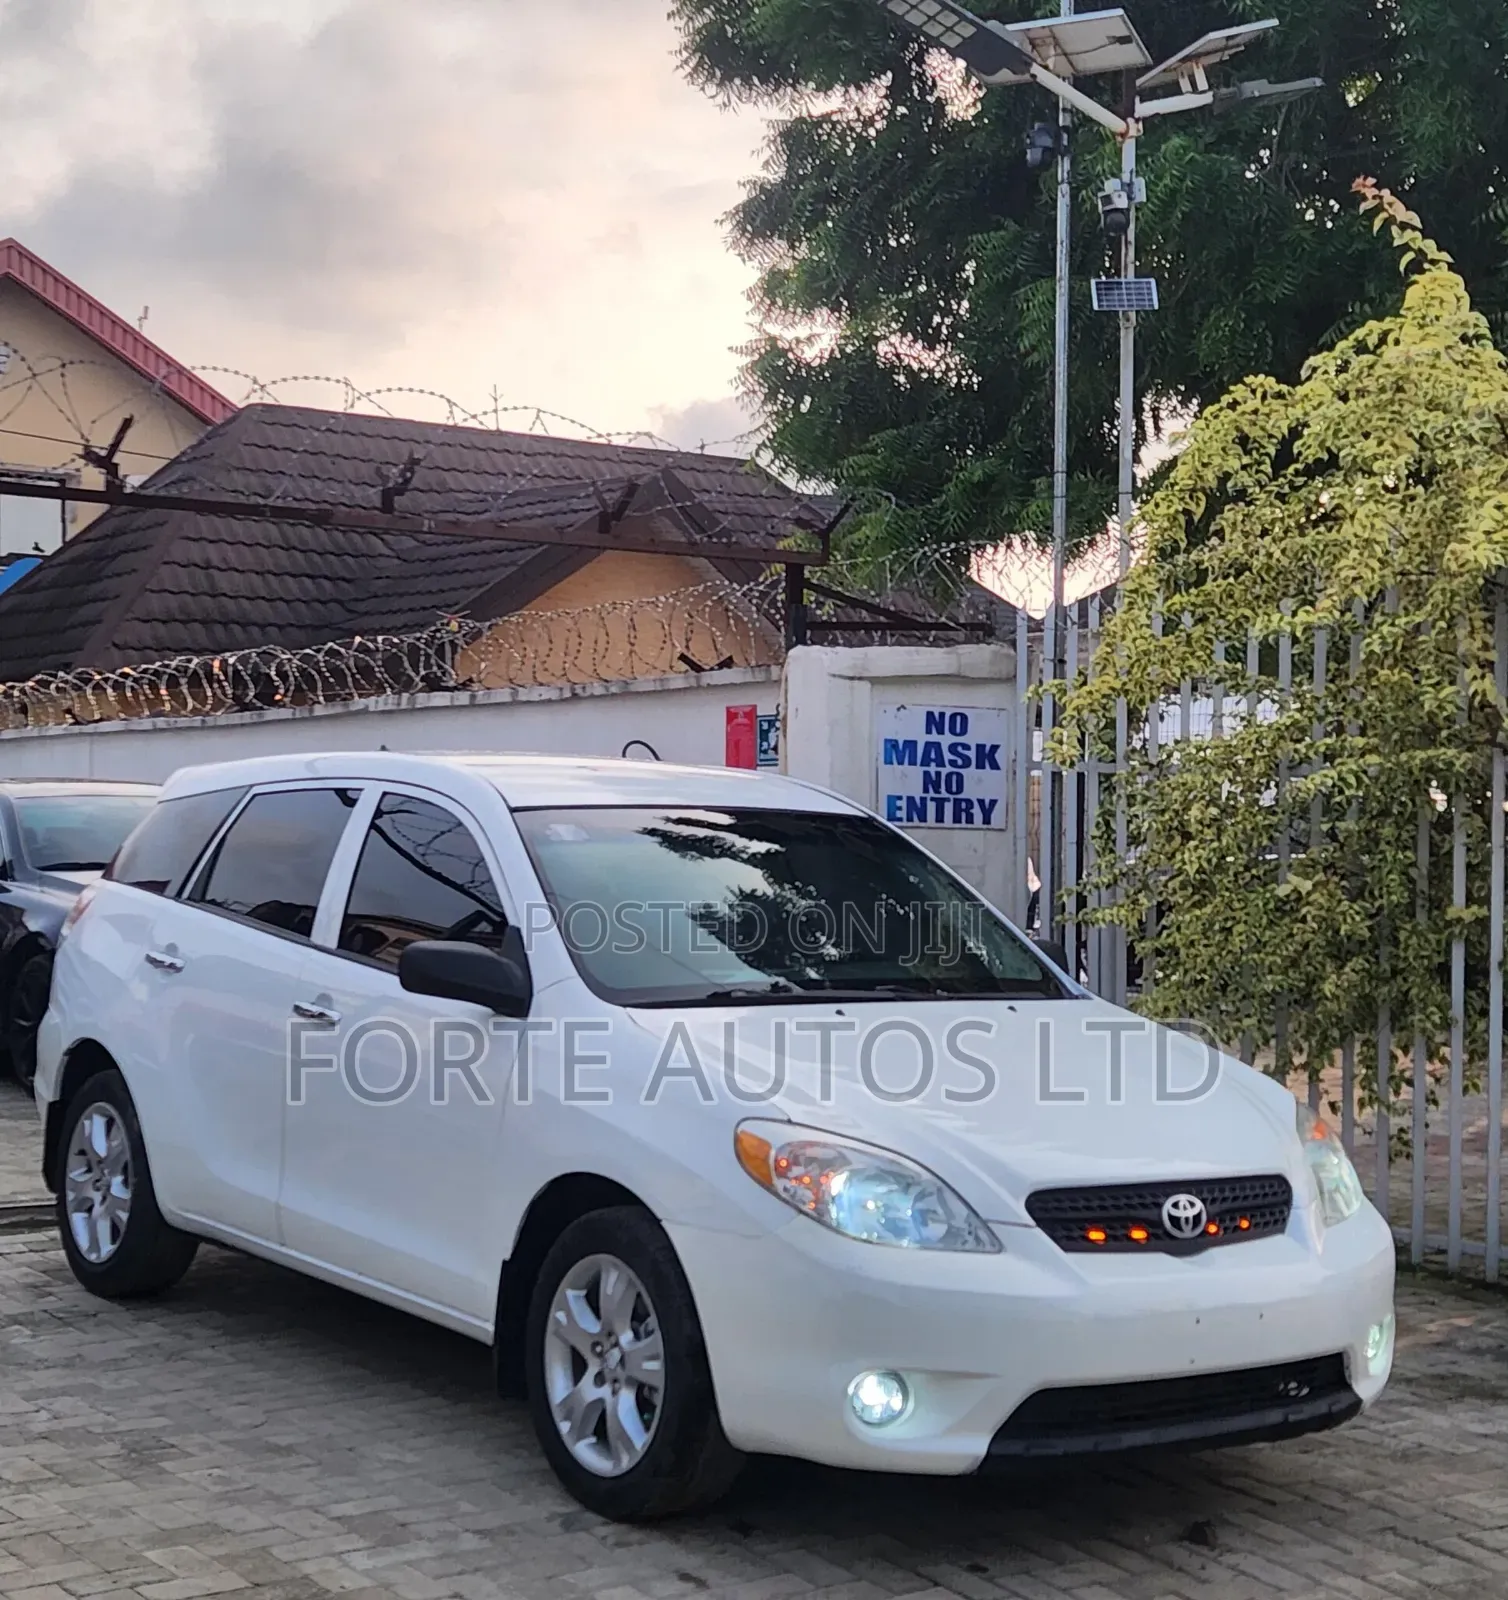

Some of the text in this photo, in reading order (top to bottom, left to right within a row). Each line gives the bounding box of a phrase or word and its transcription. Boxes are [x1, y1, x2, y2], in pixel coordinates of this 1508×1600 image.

[925, 710, 969, 737] NO
[884, 738, 1001, 770] MASK
[922, 770, 964, 795] NO
[886, 794, 999, 825] ENTRY
